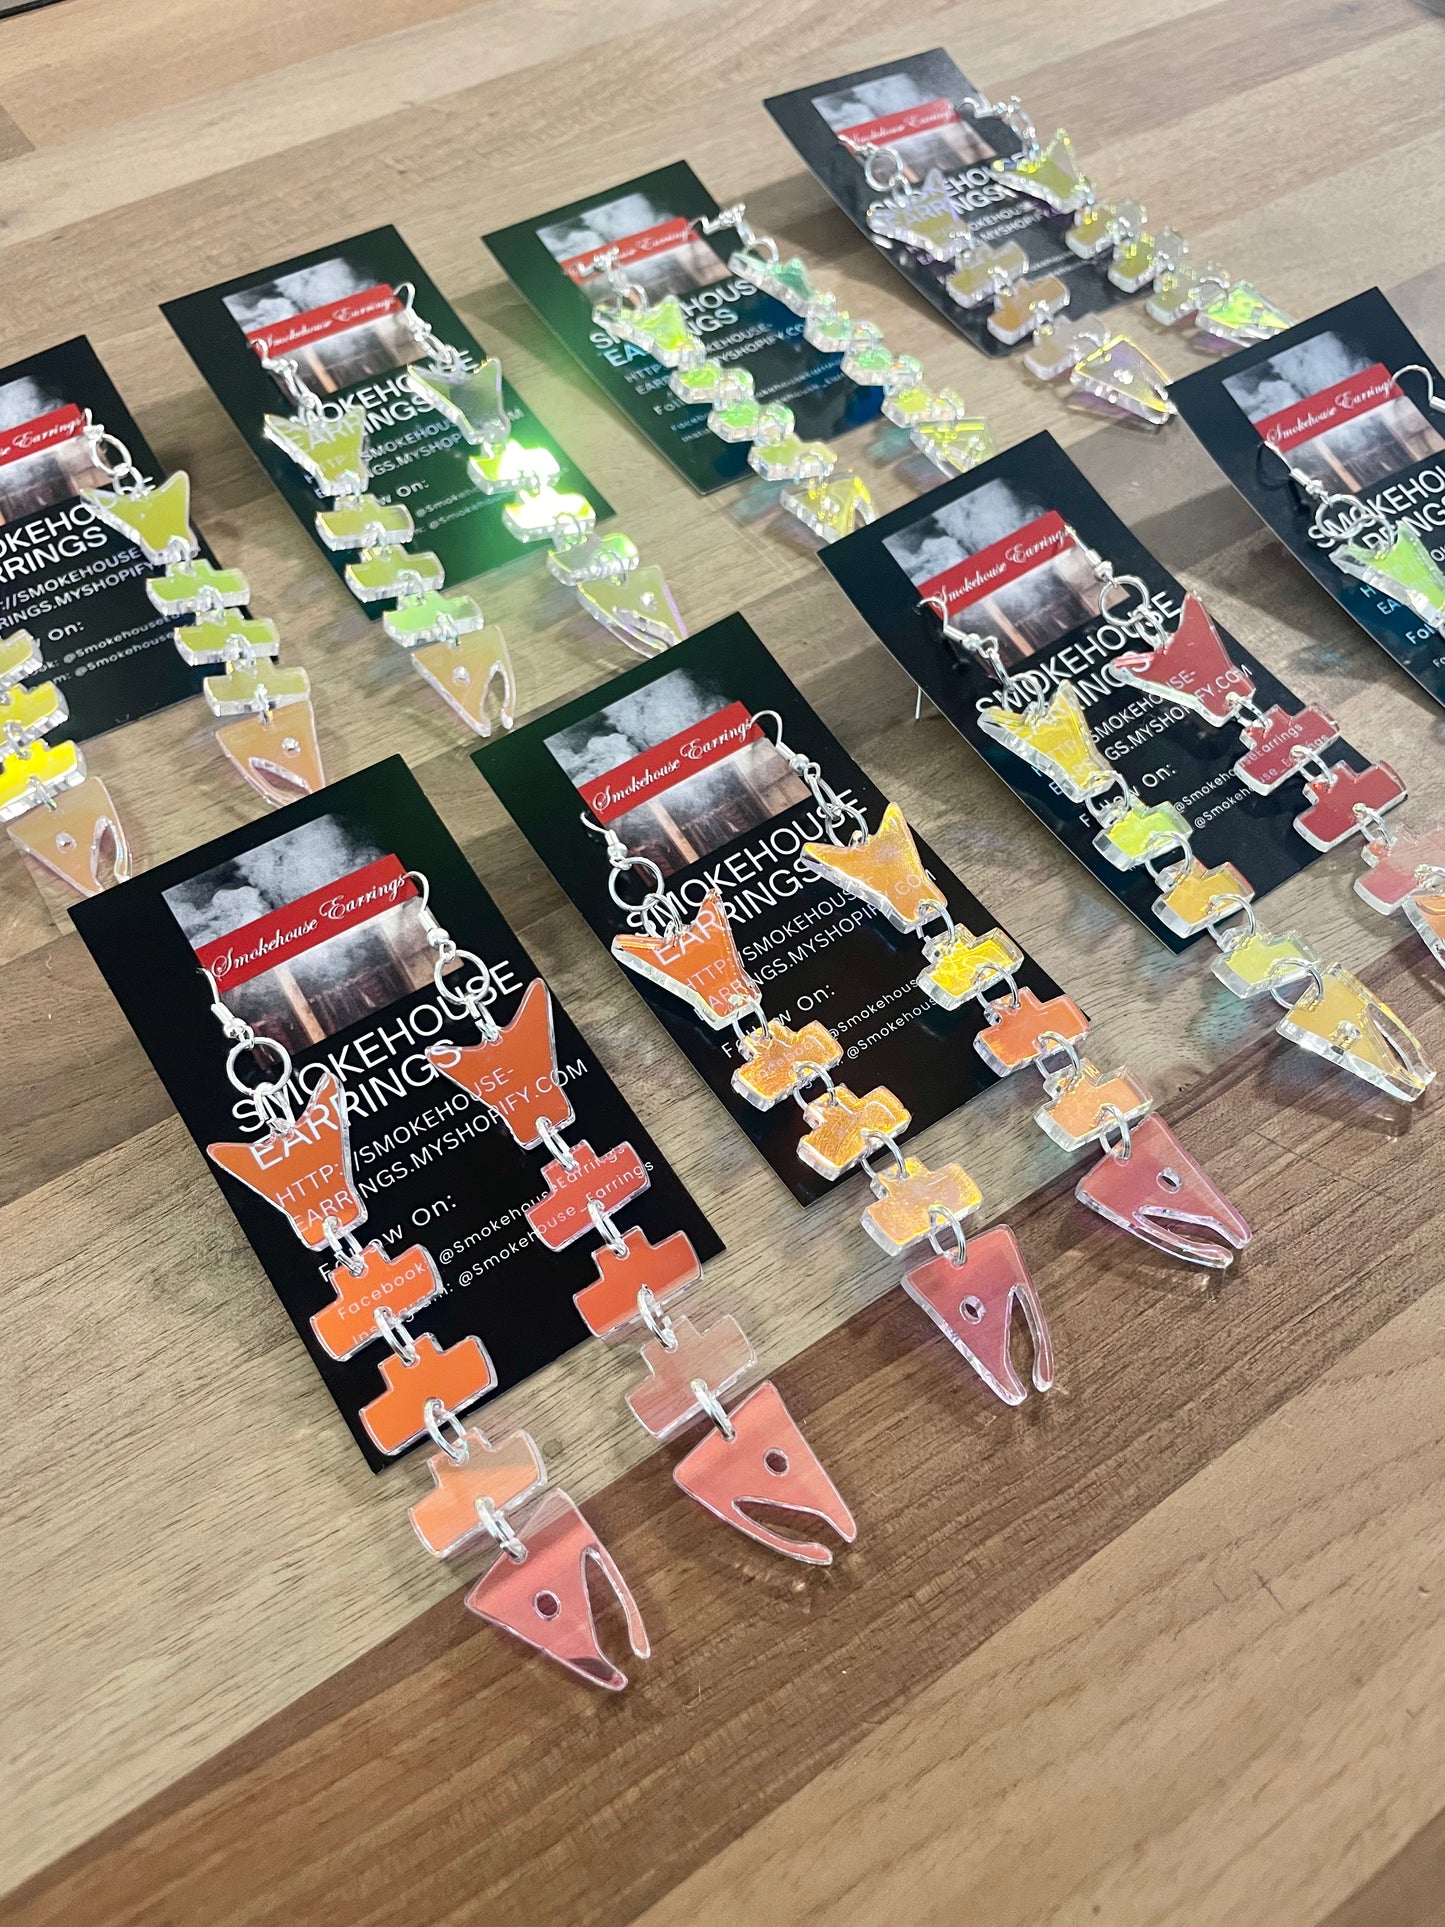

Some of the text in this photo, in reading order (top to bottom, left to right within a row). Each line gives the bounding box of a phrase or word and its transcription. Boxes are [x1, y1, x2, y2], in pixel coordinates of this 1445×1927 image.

[603, 307, 739, 367] EANGS
[1266, 405, 1338, 444] Smokehouse
[929, 524, 1068, 609] Smokehouse Earring
[48, 621, 85, 641] On:
[592, 760, 680, 815] Smokehouse
[1142, 763, 1176, 788] On:
[626, 789, 868, 937] SMOKEHOUSE
[210, 873, 406, 983] Smokehouse Earrings
[797, 984, 836, 1011] On:
[830, 978, 919, 1041] @Smokehous
[846, 997, 938, 1060] @Smokehous
[231, 959, 523, 1133] SMOKEHOUSE
[250, 1038, 463, 1171] EARRINGS
[276, 1067, 514, 1207] HTTP:/SMOKEHOUSE-
[294, 1058, 588, 1234] EARRNGS.MYSHOPIFY.COM
[412, 1194, 458, 1227] On:
[439, 1147, 625, 1265] @SmokehousEarrings
